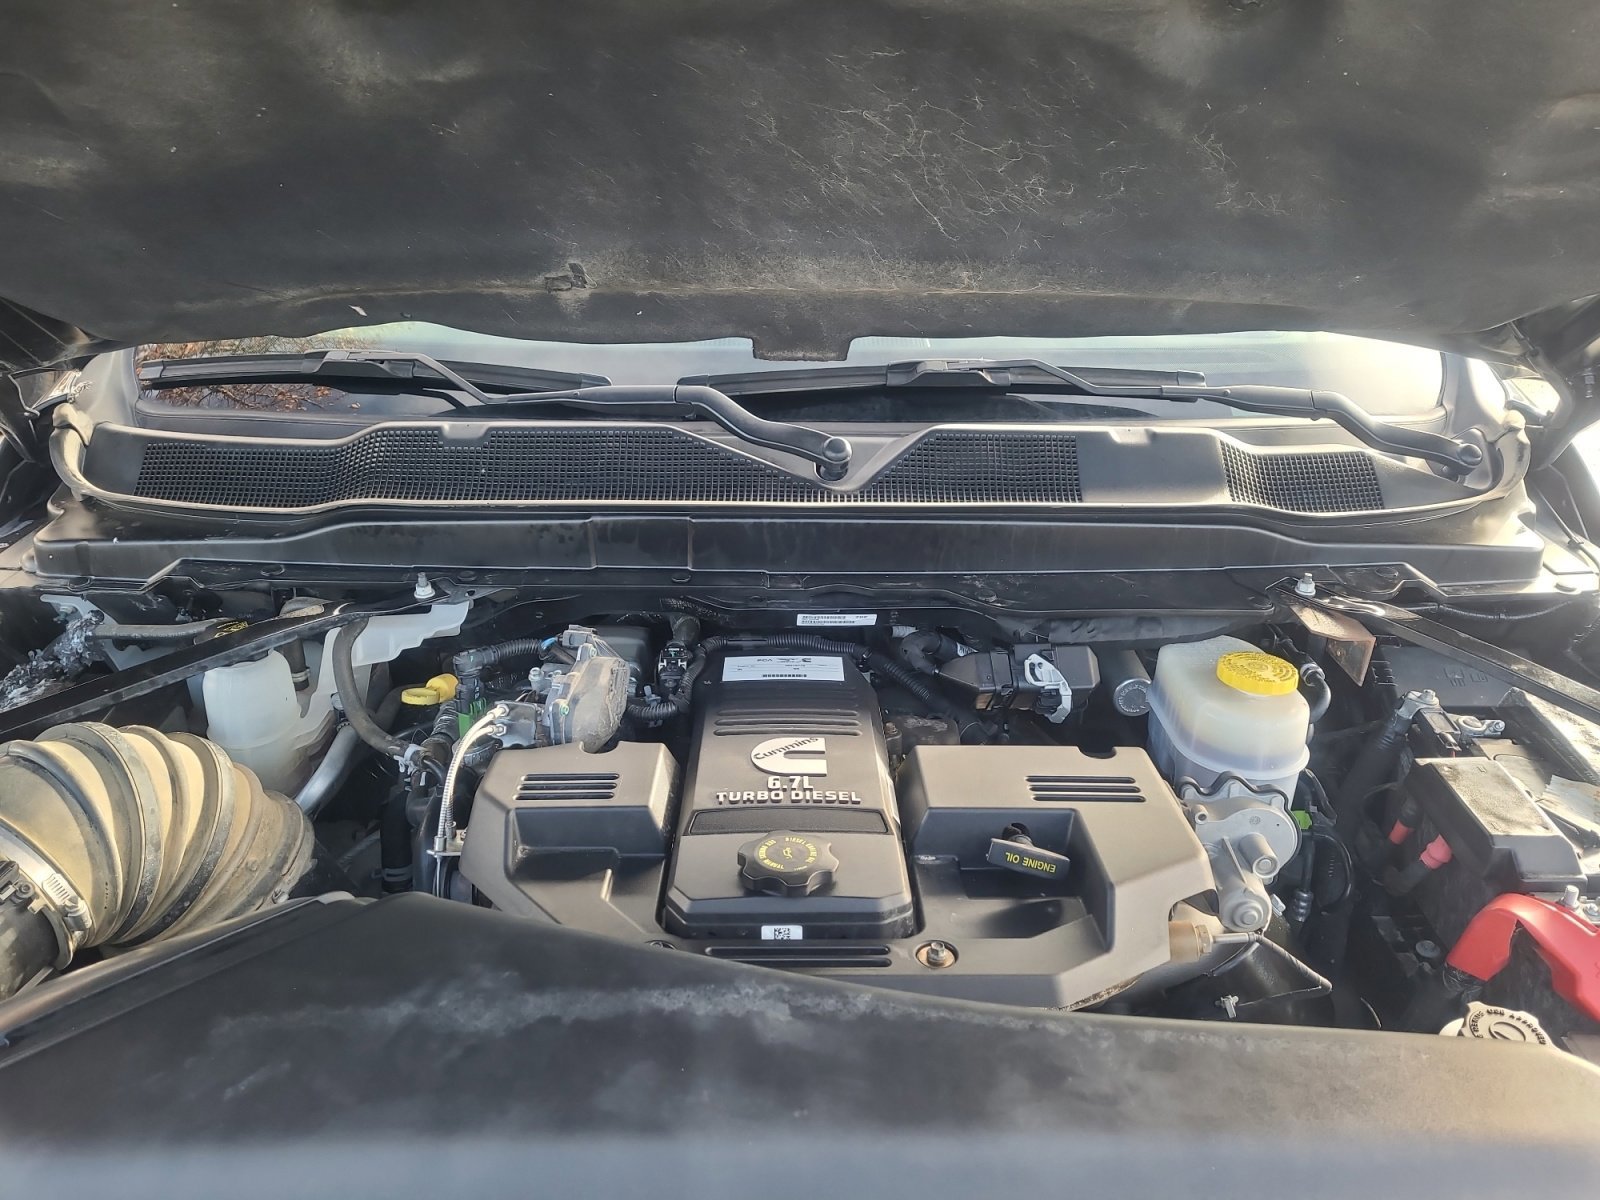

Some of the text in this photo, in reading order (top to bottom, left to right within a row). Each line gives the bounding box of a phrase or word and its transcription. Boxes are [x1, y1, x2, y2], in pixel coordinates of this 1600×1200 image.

[753, 736, 819, 760] Cummins
[767, 776, 814, 791] 6.7L
[716, 790, 862, 804] TURBO DIESEL
[1005, 852, 1056, 873] ENGINE OIL
